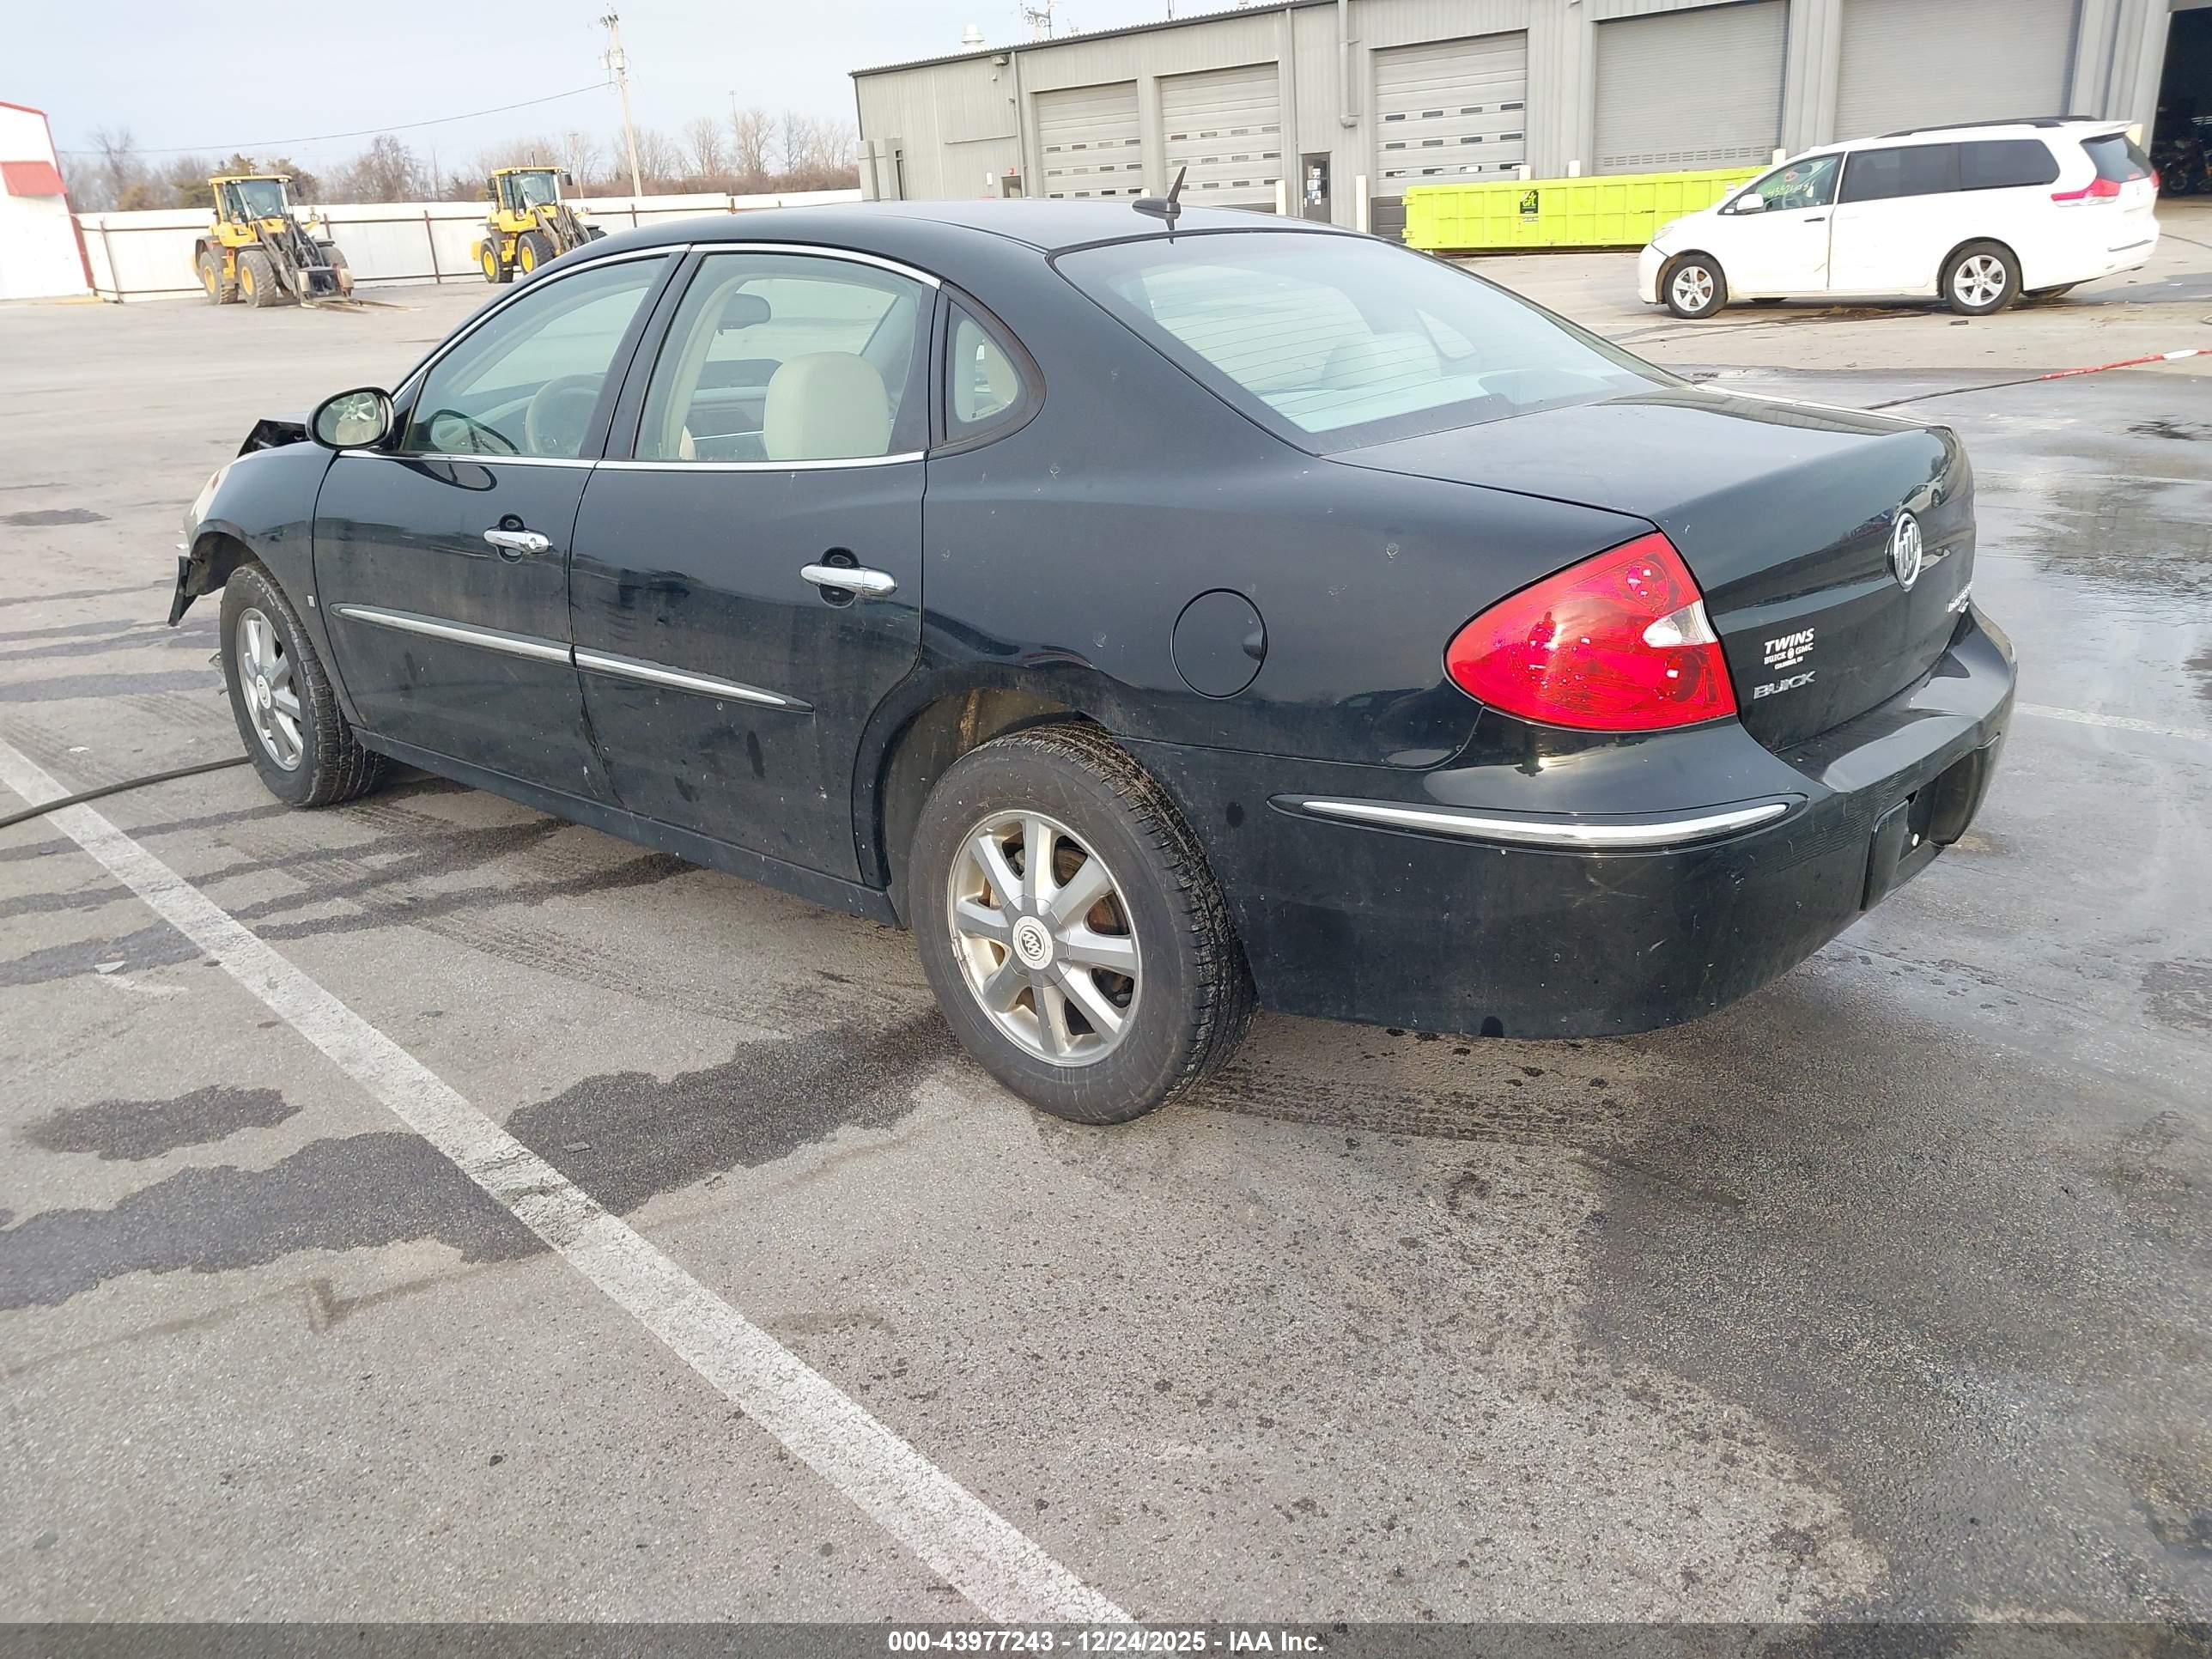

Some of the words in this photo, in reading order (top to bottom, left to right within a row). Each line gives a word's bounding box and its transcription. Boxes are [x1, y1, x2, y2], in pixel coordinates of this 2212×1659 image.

[1764, 628, 1814, 655] TWINS
[1764, 651, 1787, 665] BUICK
[1796, 642, 1814, 655] GMC
[1753, 671, 1816, 700] BUICK
